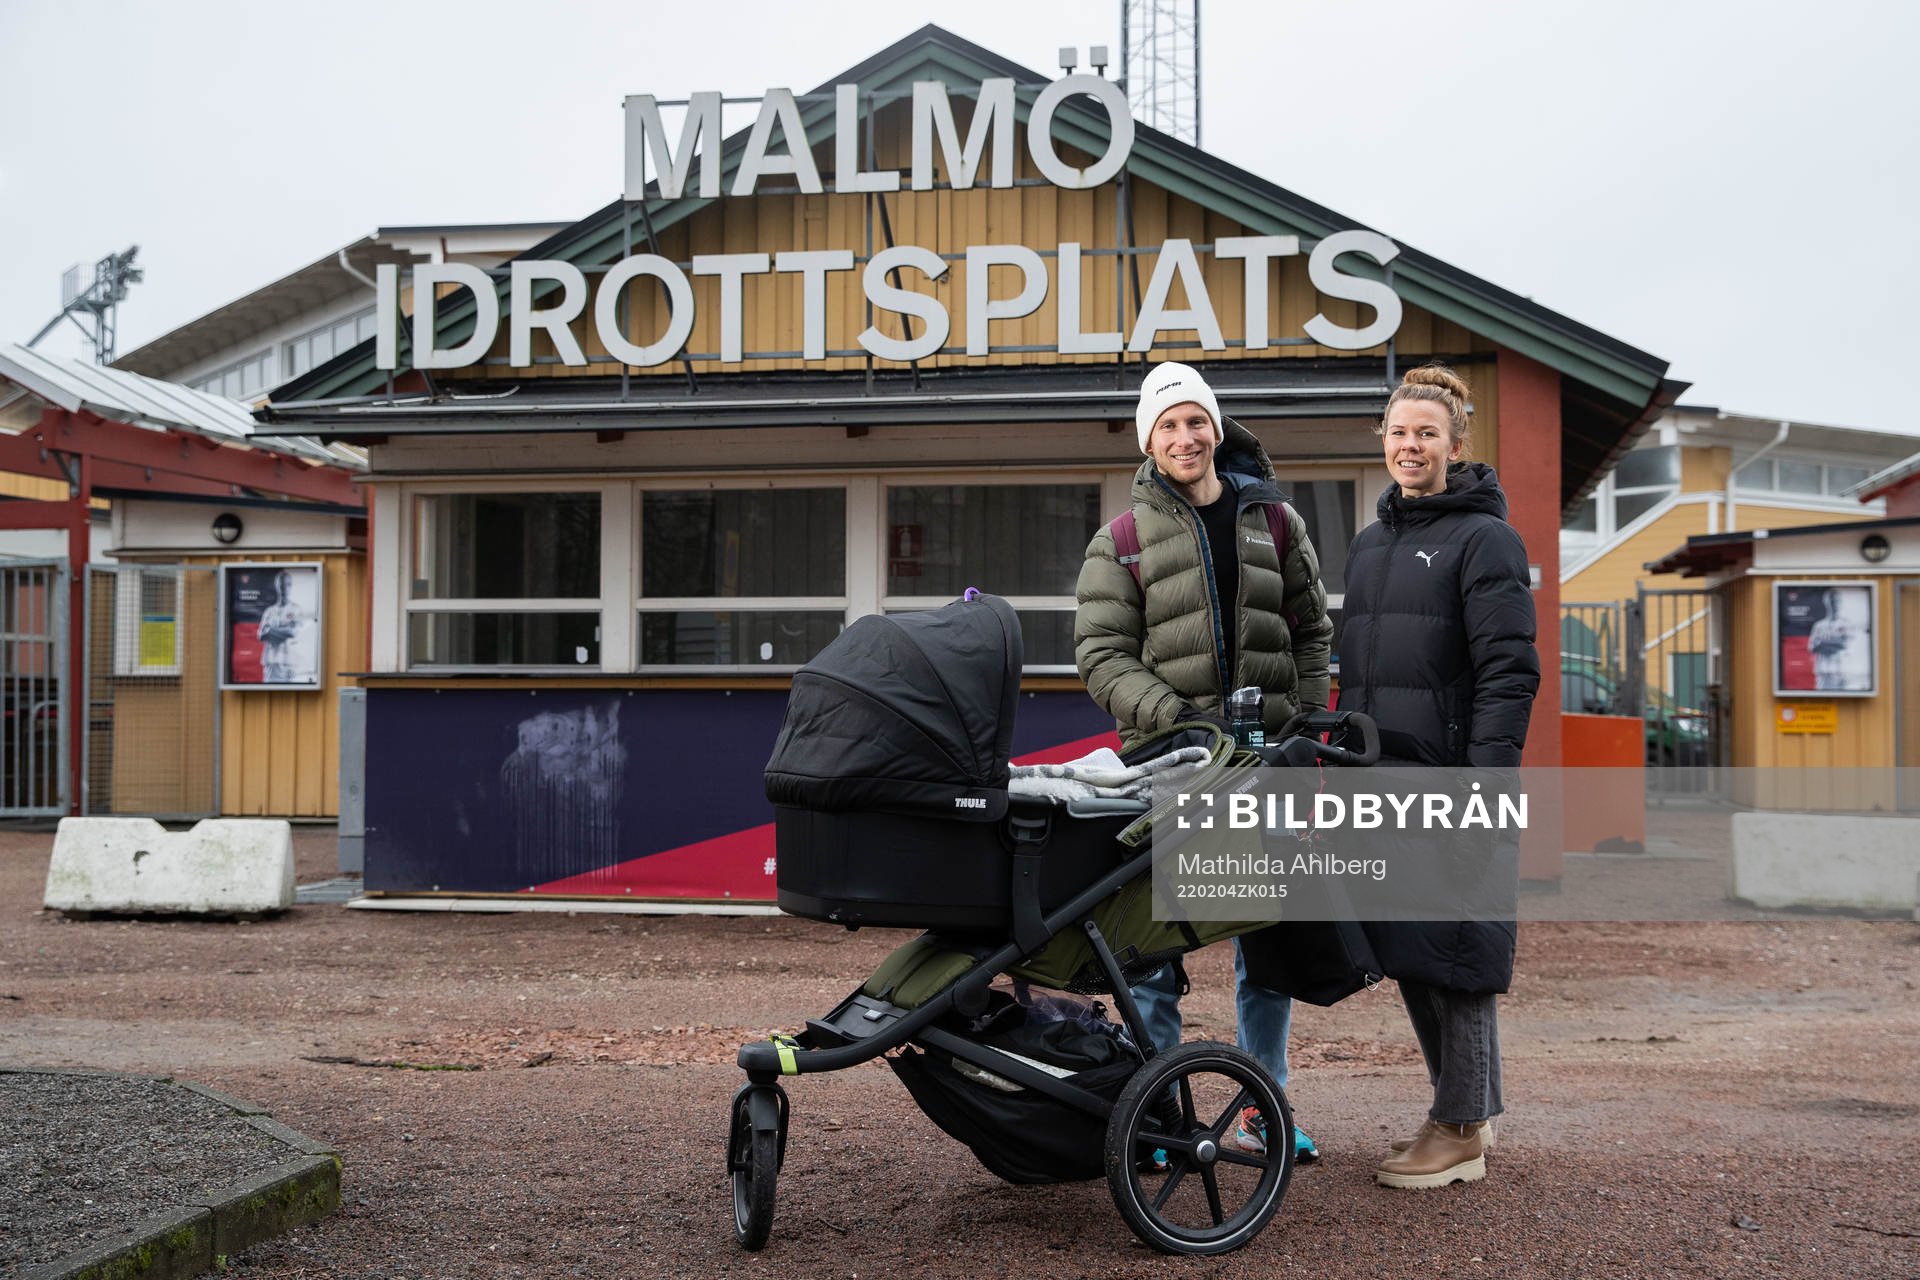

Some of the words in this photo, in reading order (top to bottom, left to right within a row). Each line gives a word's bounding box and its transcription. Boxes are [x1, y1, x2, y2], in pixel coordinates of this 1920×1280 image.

[623, 45, 1136, 201] MALMÖ
[376, 229, 1403, 370] IDROTTSPLATS
[954, 797, 987, 809] THULE
